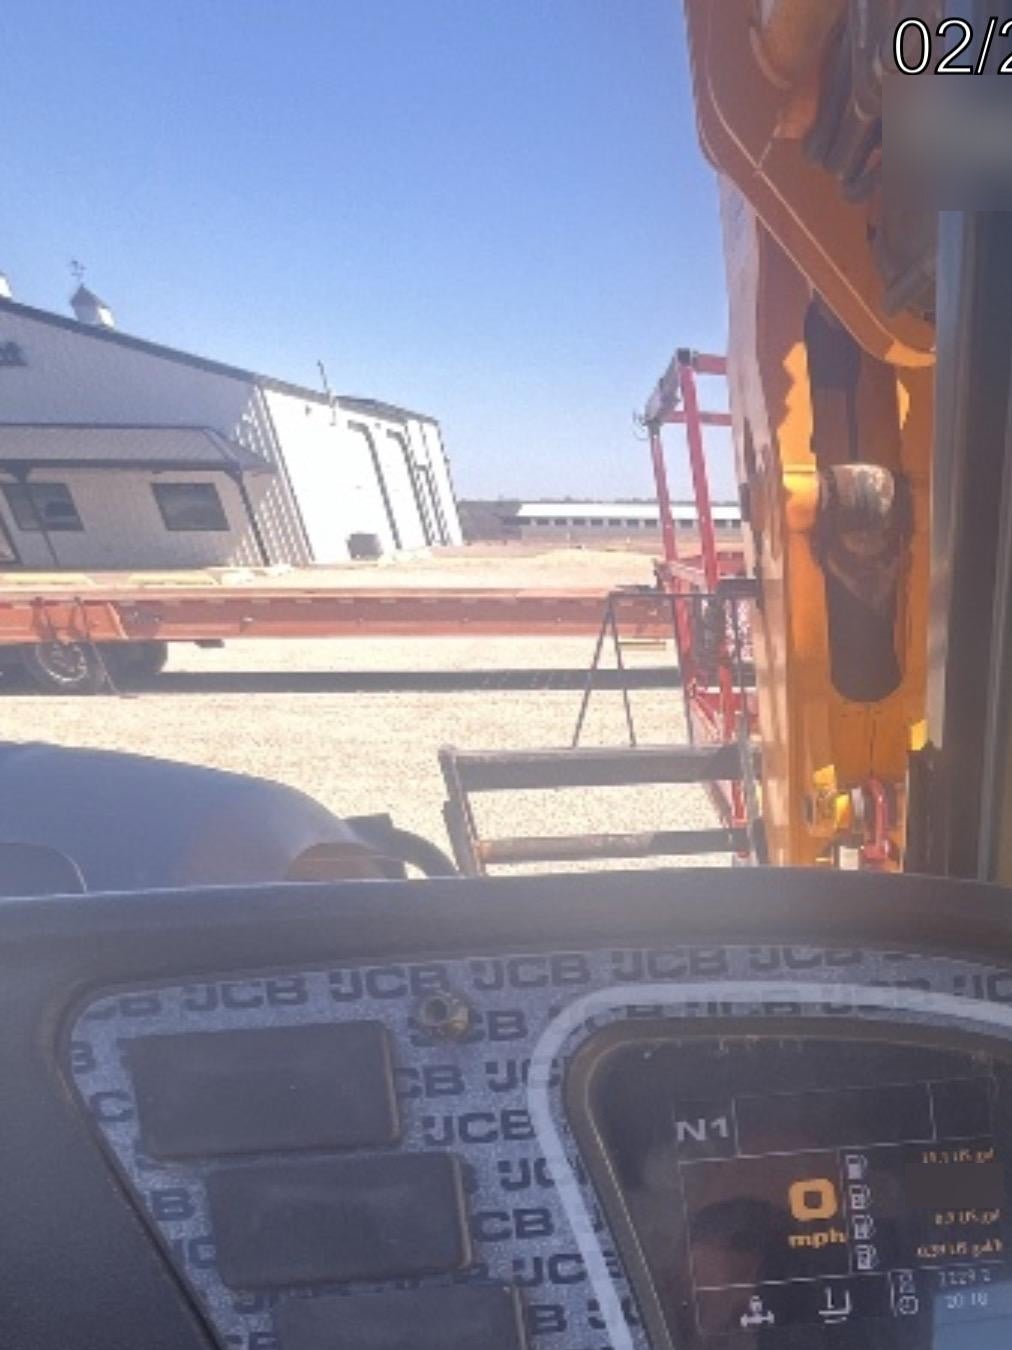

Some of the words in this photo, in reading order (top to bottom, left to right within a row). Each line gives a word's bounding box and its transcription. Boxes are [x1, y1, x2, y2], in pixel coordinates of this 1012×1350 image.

[329, 966, 448, 1001] JCB
[470, 954, 591, 990] JCB
[611, 949, 728, 980] JCB
[675, 1116, 729, 1142] N1
[788, 1178, 838, 1221] 0
[473, 1208, 553, 1242] CB
[789, 1228, 847, 1248] mph
